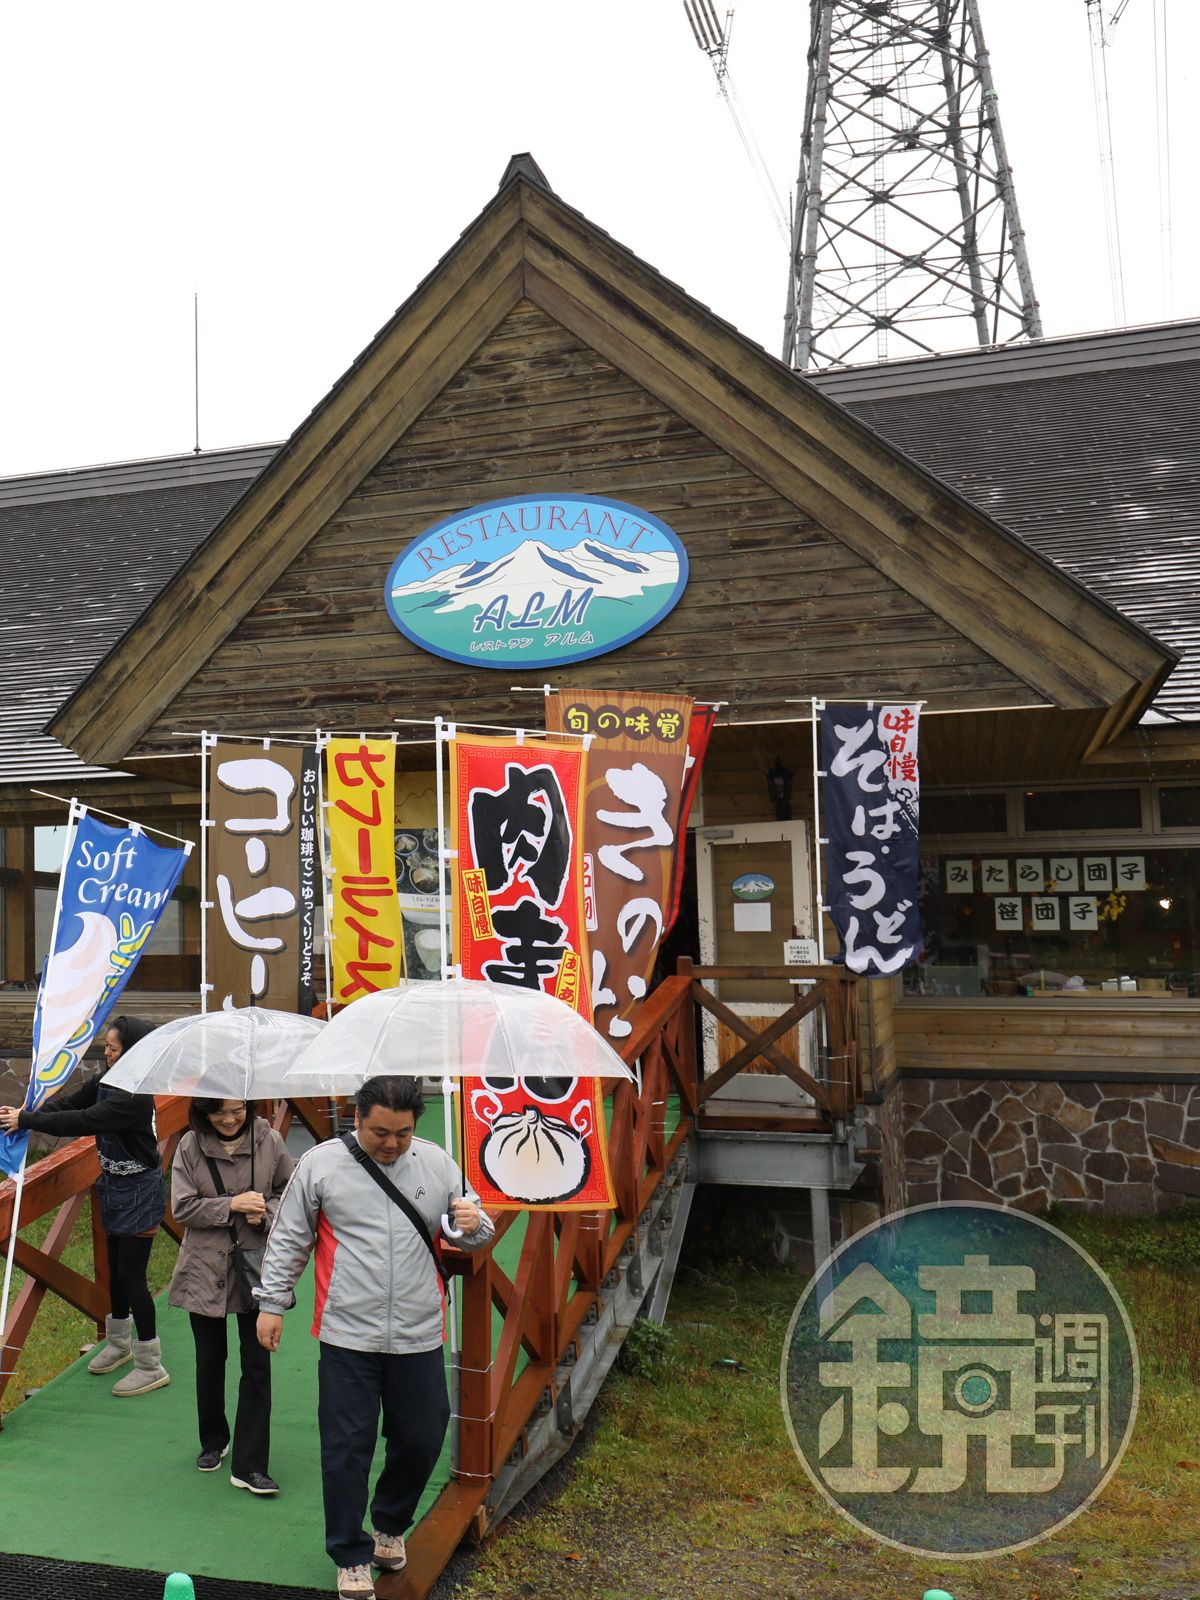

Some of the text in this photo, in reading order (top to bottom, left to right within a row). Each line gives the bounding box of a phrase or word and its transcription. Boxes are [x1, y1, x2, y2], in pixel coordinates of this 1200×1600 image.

[415, 505, 653, 571] RESTAURANT
[472, 586, 595, 633] ALM
[469, 631, 594, 652] レストラン アルム
[567, 707, 680, 739] 旬の味覚
[883, 708, 918, 783] 味自慢
[77, 837, 138, 883] Soft
[216, 758, 297, 996] コーヒー
[300, 768, 317, 987] おいしい珈琲でごゆっくりどうぞ
[950, 863, 1142, 883] みたらし団子
[78, 877, 169, 909] Cream
[464, 873, 490, 937] 味自慢
[998, 903, 1095, 921] 笹団子
[558, 954, 578, 1010] あつあ
